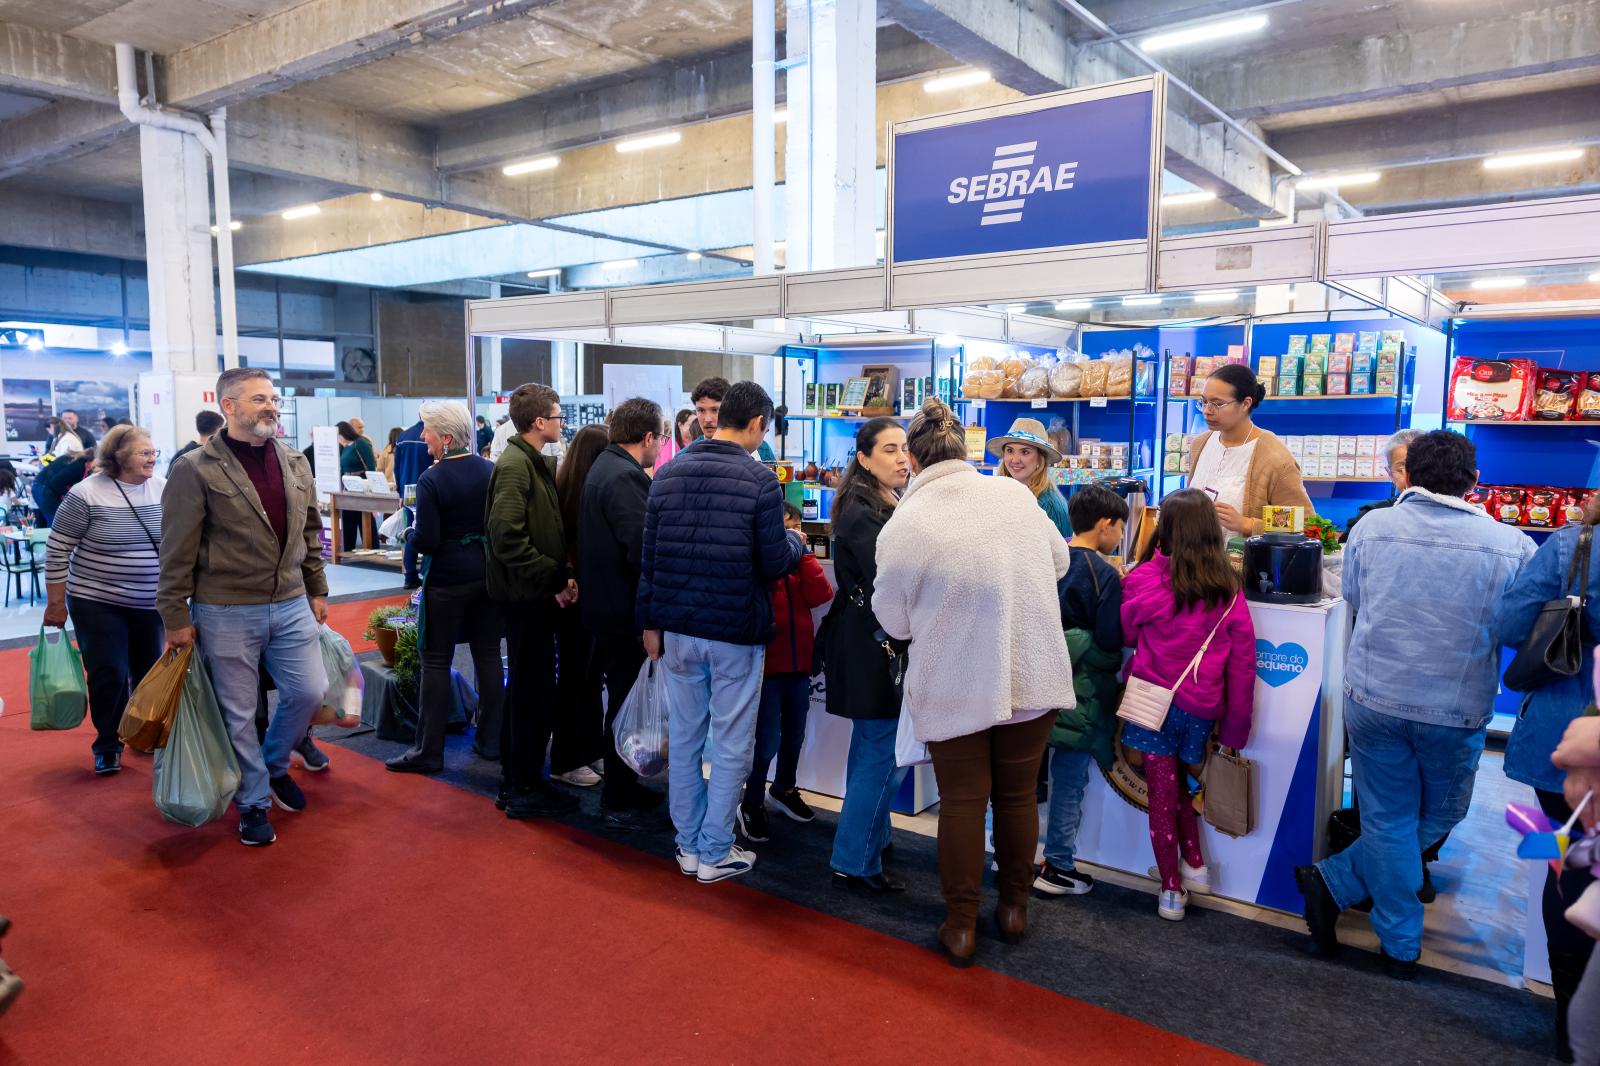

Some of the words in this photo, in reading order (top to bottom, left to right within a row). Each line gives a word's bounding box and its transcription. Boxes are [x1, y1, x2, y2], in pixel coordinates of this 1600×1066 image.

[947, 161, 1079, 204] SEBRAE
[1256, 651, 1288, 662] ompre
[1289, 654, 1304, 664] do
[1256, 659, 1304, 673] equeno
